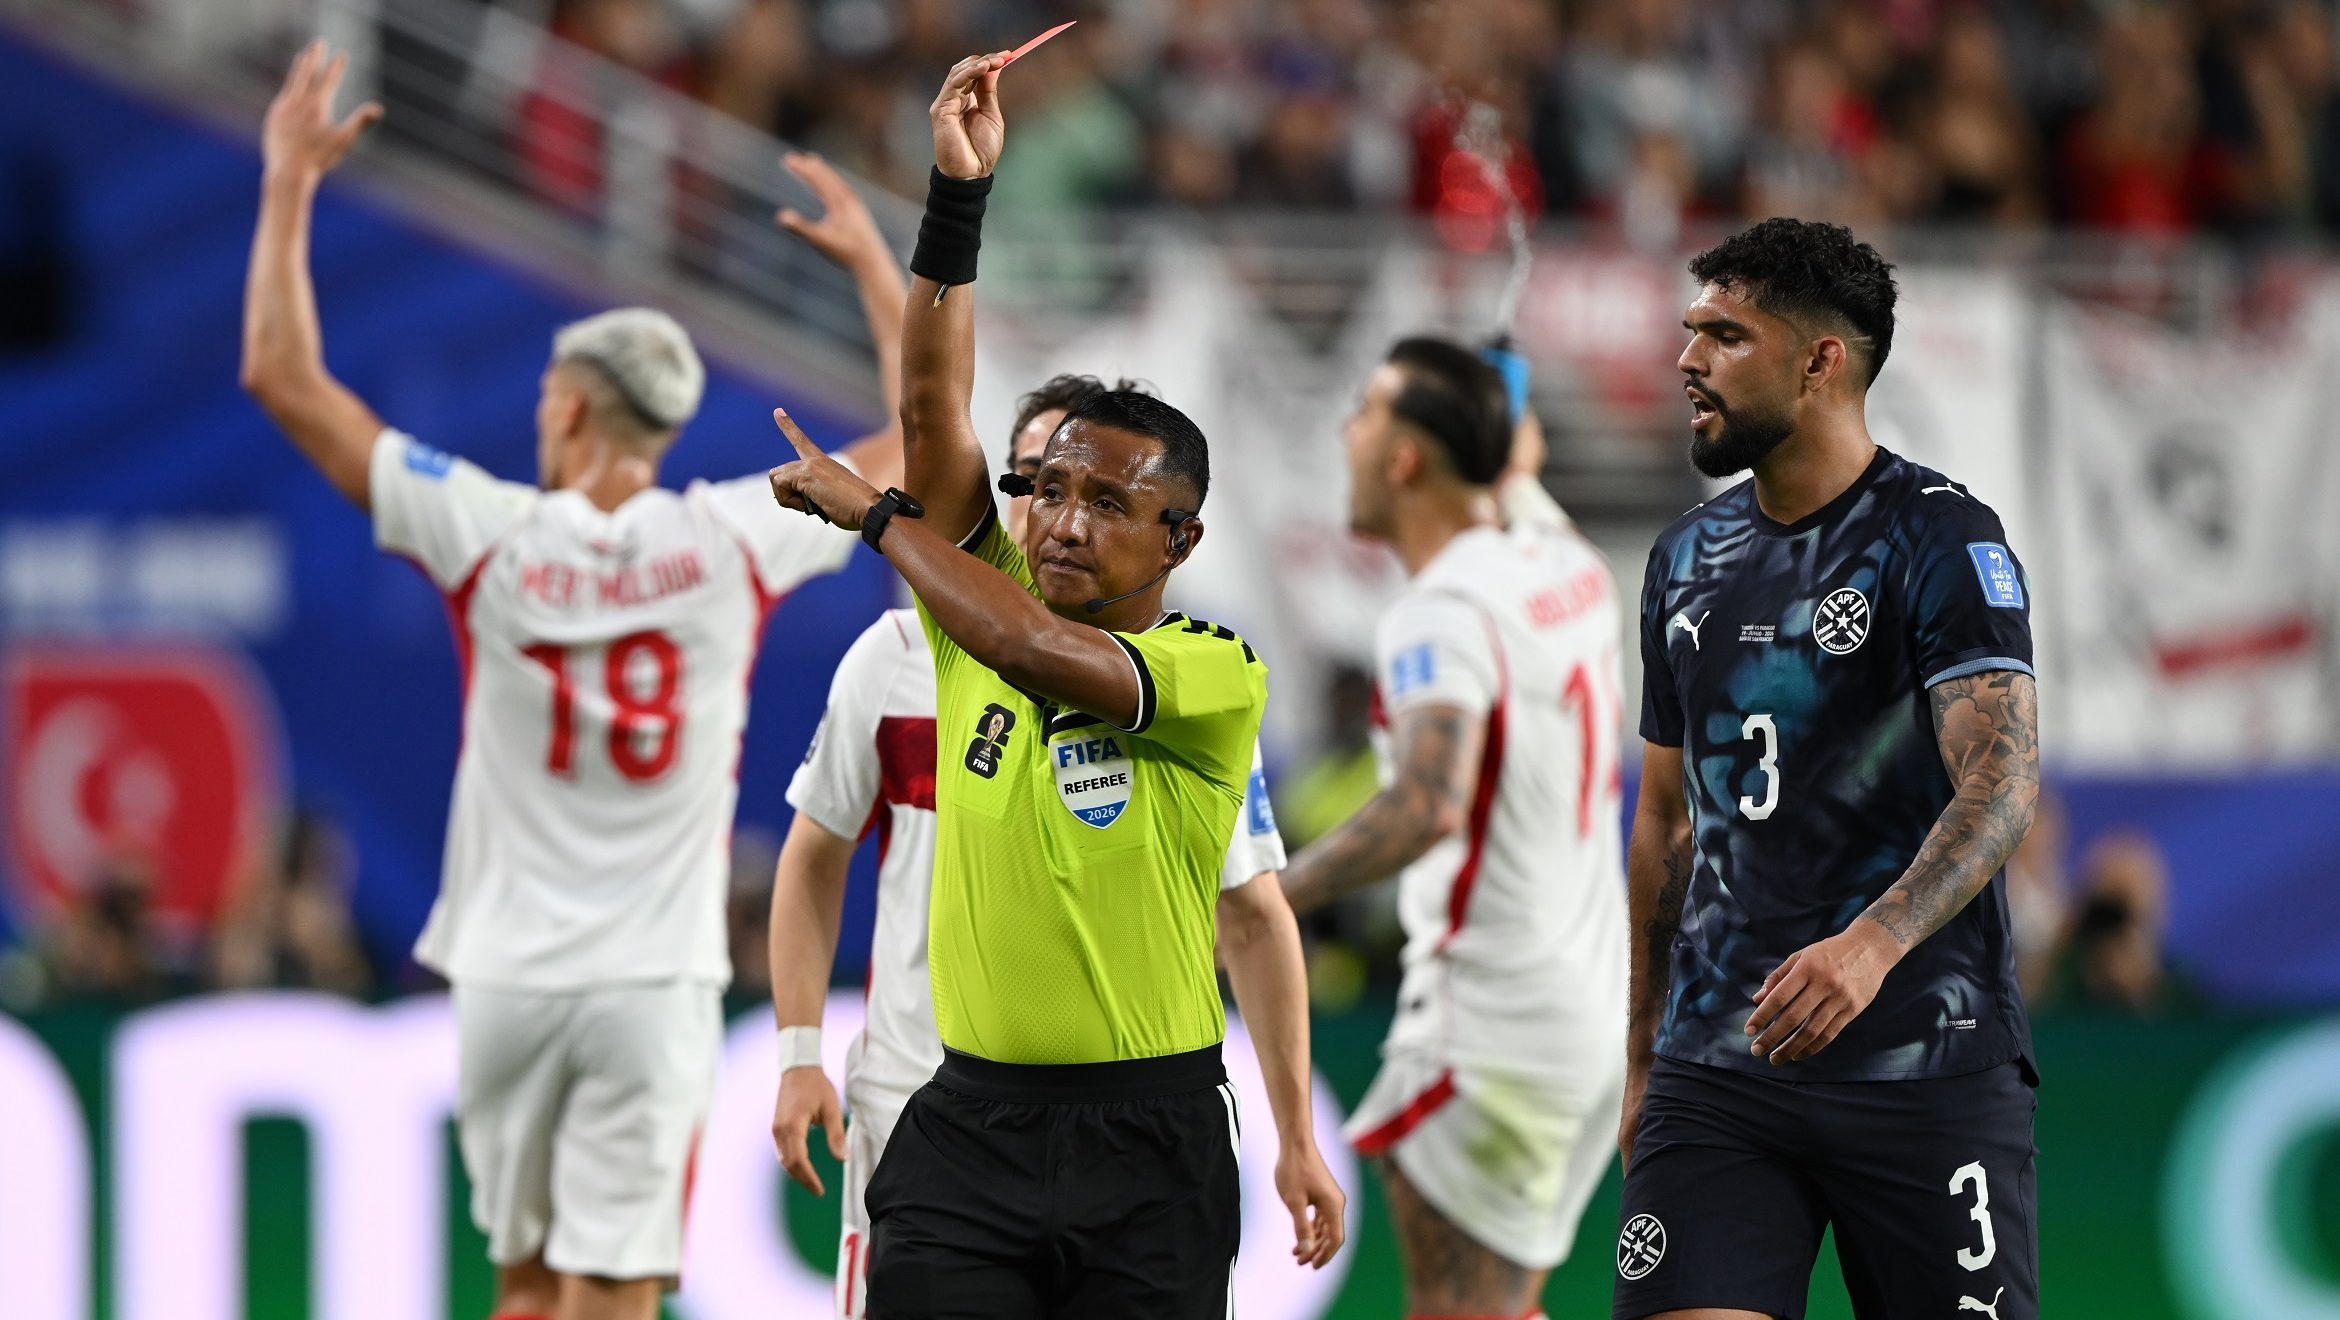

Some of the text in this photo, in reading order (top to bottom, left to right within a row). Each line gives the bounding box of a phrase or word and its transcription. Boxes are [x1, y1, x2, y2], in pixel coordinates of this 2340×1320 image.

[1836, 593, 1856, 605] APF
[1825, 640, 1853, 651] PARAGUAY
[518, 629, 684, 785] 18
[1057, 736, 1123, 768] FIFA
[972, 758, 990, 773] FIFA
[1739, 713, 1779, 821] 3
[1063, 773, 1127, 795] REFEREE
[1087, 806, 1116, 821] 2026
[1948, 1160, 1997, 1272] 3
[1631, 1219, 1646, 1233] APF
[1627, 1264, 1649, 1276] PARAGUAY
